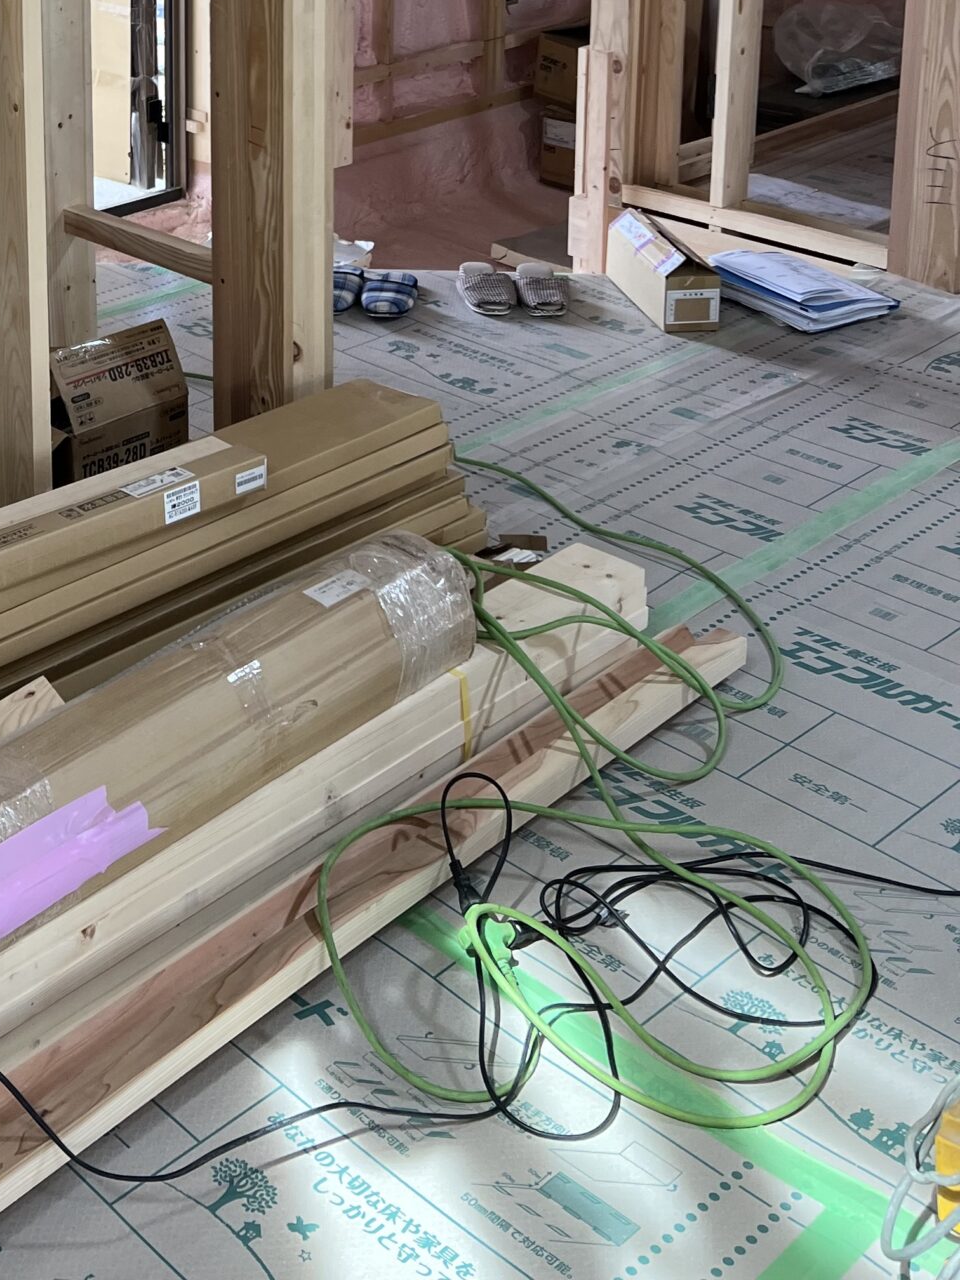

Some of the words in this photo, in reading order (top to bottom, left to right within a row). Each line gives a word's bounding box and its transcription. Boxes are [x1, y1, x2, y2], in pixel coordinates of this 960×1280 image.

[107, 348, 173, 382] TCB39-28D
[792, 626, 902, 673] フクビ養生板
[788, 772, 869, 814] 安全第一
